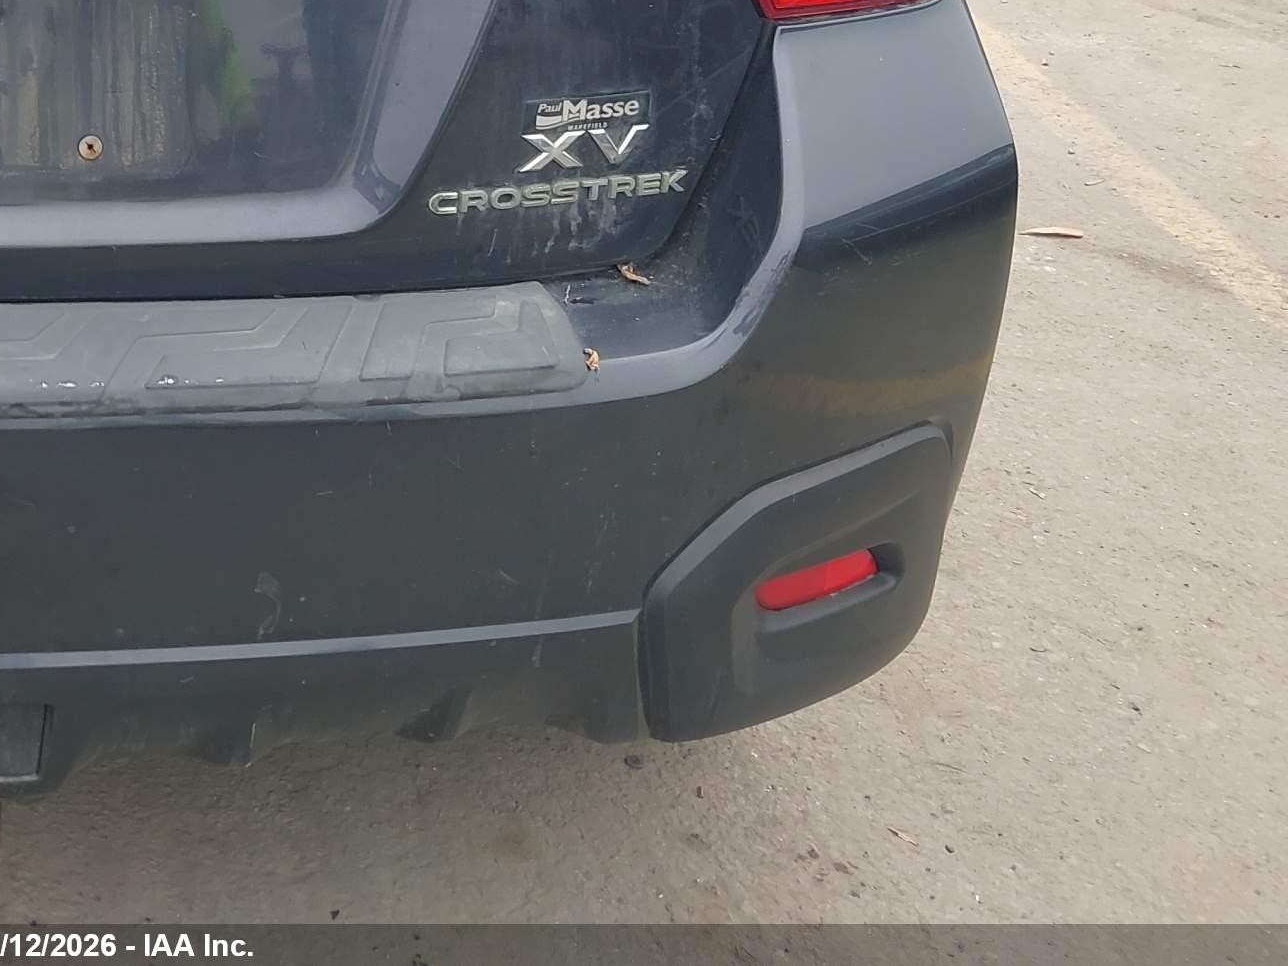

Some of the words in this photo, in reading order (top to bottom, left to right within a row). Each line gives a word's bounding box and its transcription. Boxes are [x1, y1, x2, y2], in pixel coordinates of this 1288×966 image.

[537, 102, 562, 114] Paul
[561, 98, 640, 122] Masse
[518, 123, 650, 173] XV
[428, 169, 689, 216] CROSSTREK
